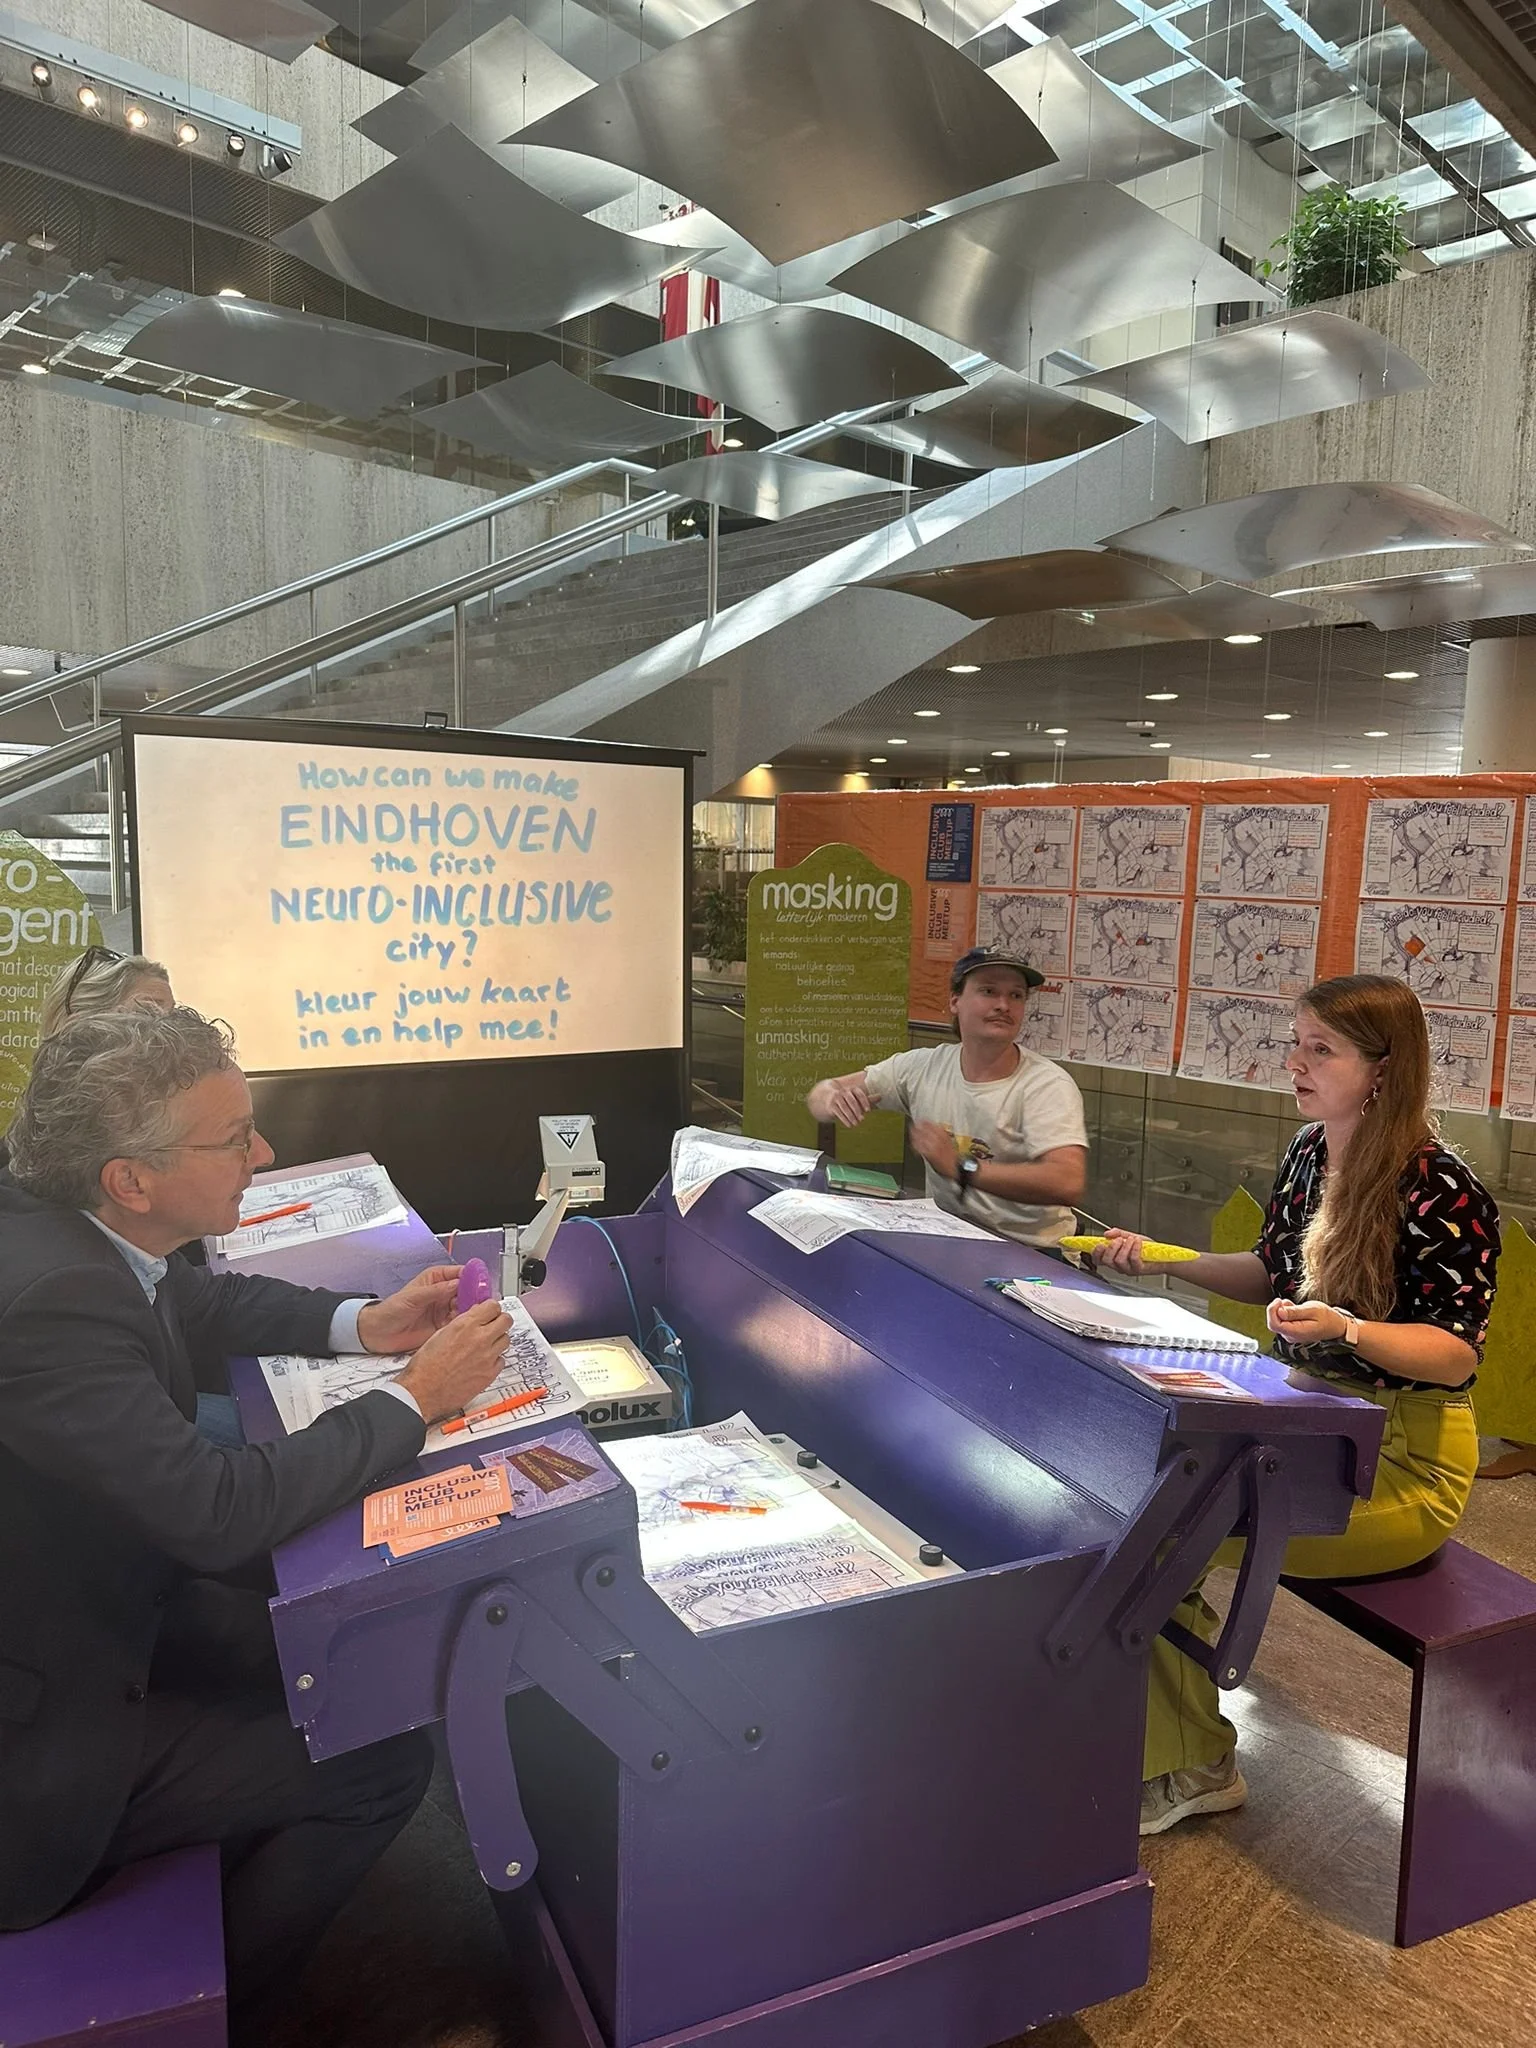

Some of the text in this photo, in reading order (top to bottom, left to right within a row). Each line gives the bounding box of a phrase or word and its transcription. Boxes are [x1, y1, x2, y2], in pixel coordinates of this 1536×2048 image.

[298, 761, 580, 801] How can we make
[280, 801, 598, 853] EINDHOVEN
[930, 808, 940, 859] INCLUSIVE
[937, 832, 945, 860] CLUB
[944, 819, 953, 860] MEETUP
[371, 852, 497, 876] the first
[762, 872, 898, 921] masking
[928, 888, 938, 939] INCLUSIVE
[935, 913, 943, 939] CLUB
[942, 899, 950, 940] MEETUP
[386, 929, 478, 969] city?
[296, 977, 571, 1019] kleur jouw kaart
[300, 1009, 558, 1049] in en help mee!
[404, 1470, 499, 1497] INCLUSIVE
[404, 1487, 454, 1505] CLUB
[405, 1489, 481, 1513] MEETUP
[708, 1580, 746, 1597] you
[746, 1574, 780, 1589] feel
[780, 1561, 858, 1585] included?
